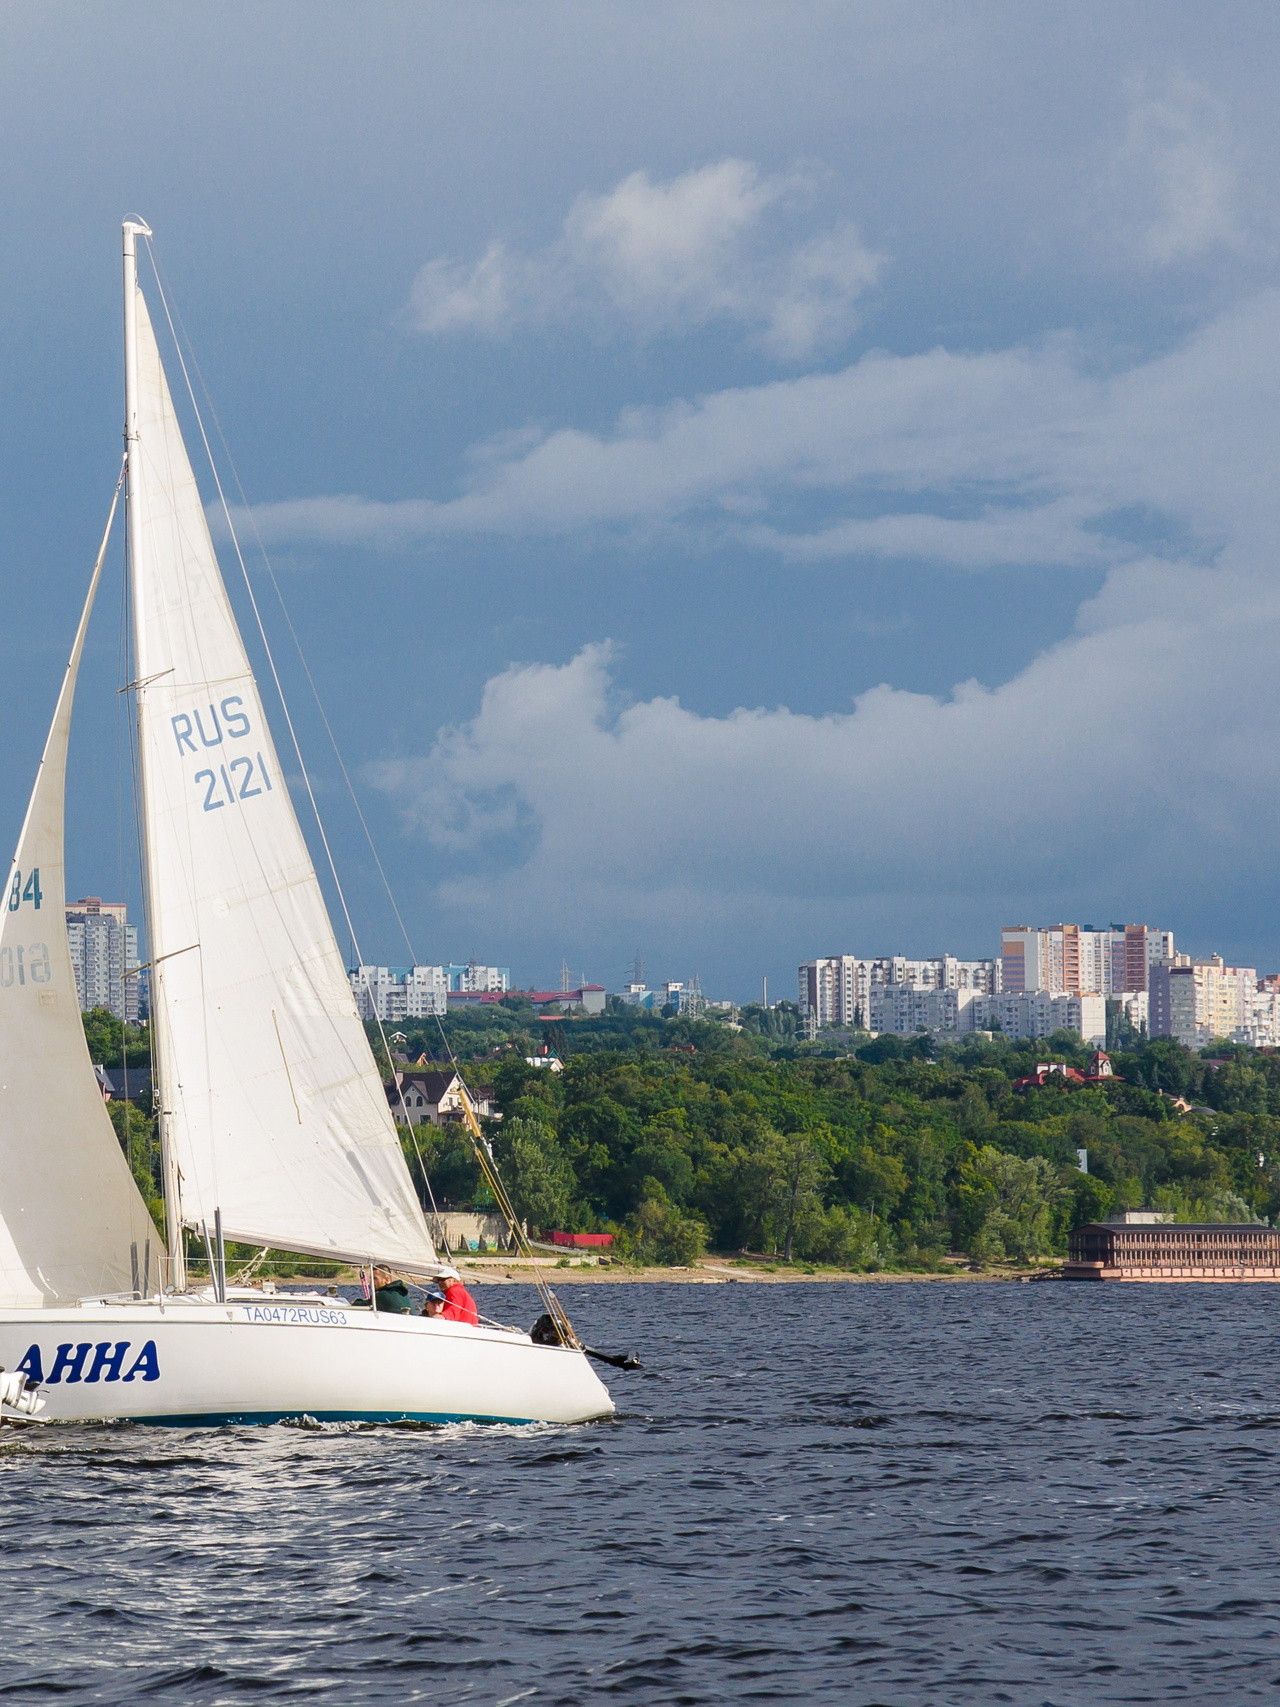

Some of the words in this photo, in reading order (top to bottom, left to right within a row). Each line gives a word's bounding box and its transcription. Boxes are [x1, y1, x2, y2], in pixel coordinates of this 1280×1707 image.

[171, 696, 251, 757] RUS
[194, 751, 273, 812] 2121
[243, 1306, 348, 1326] TA0472RUS63
